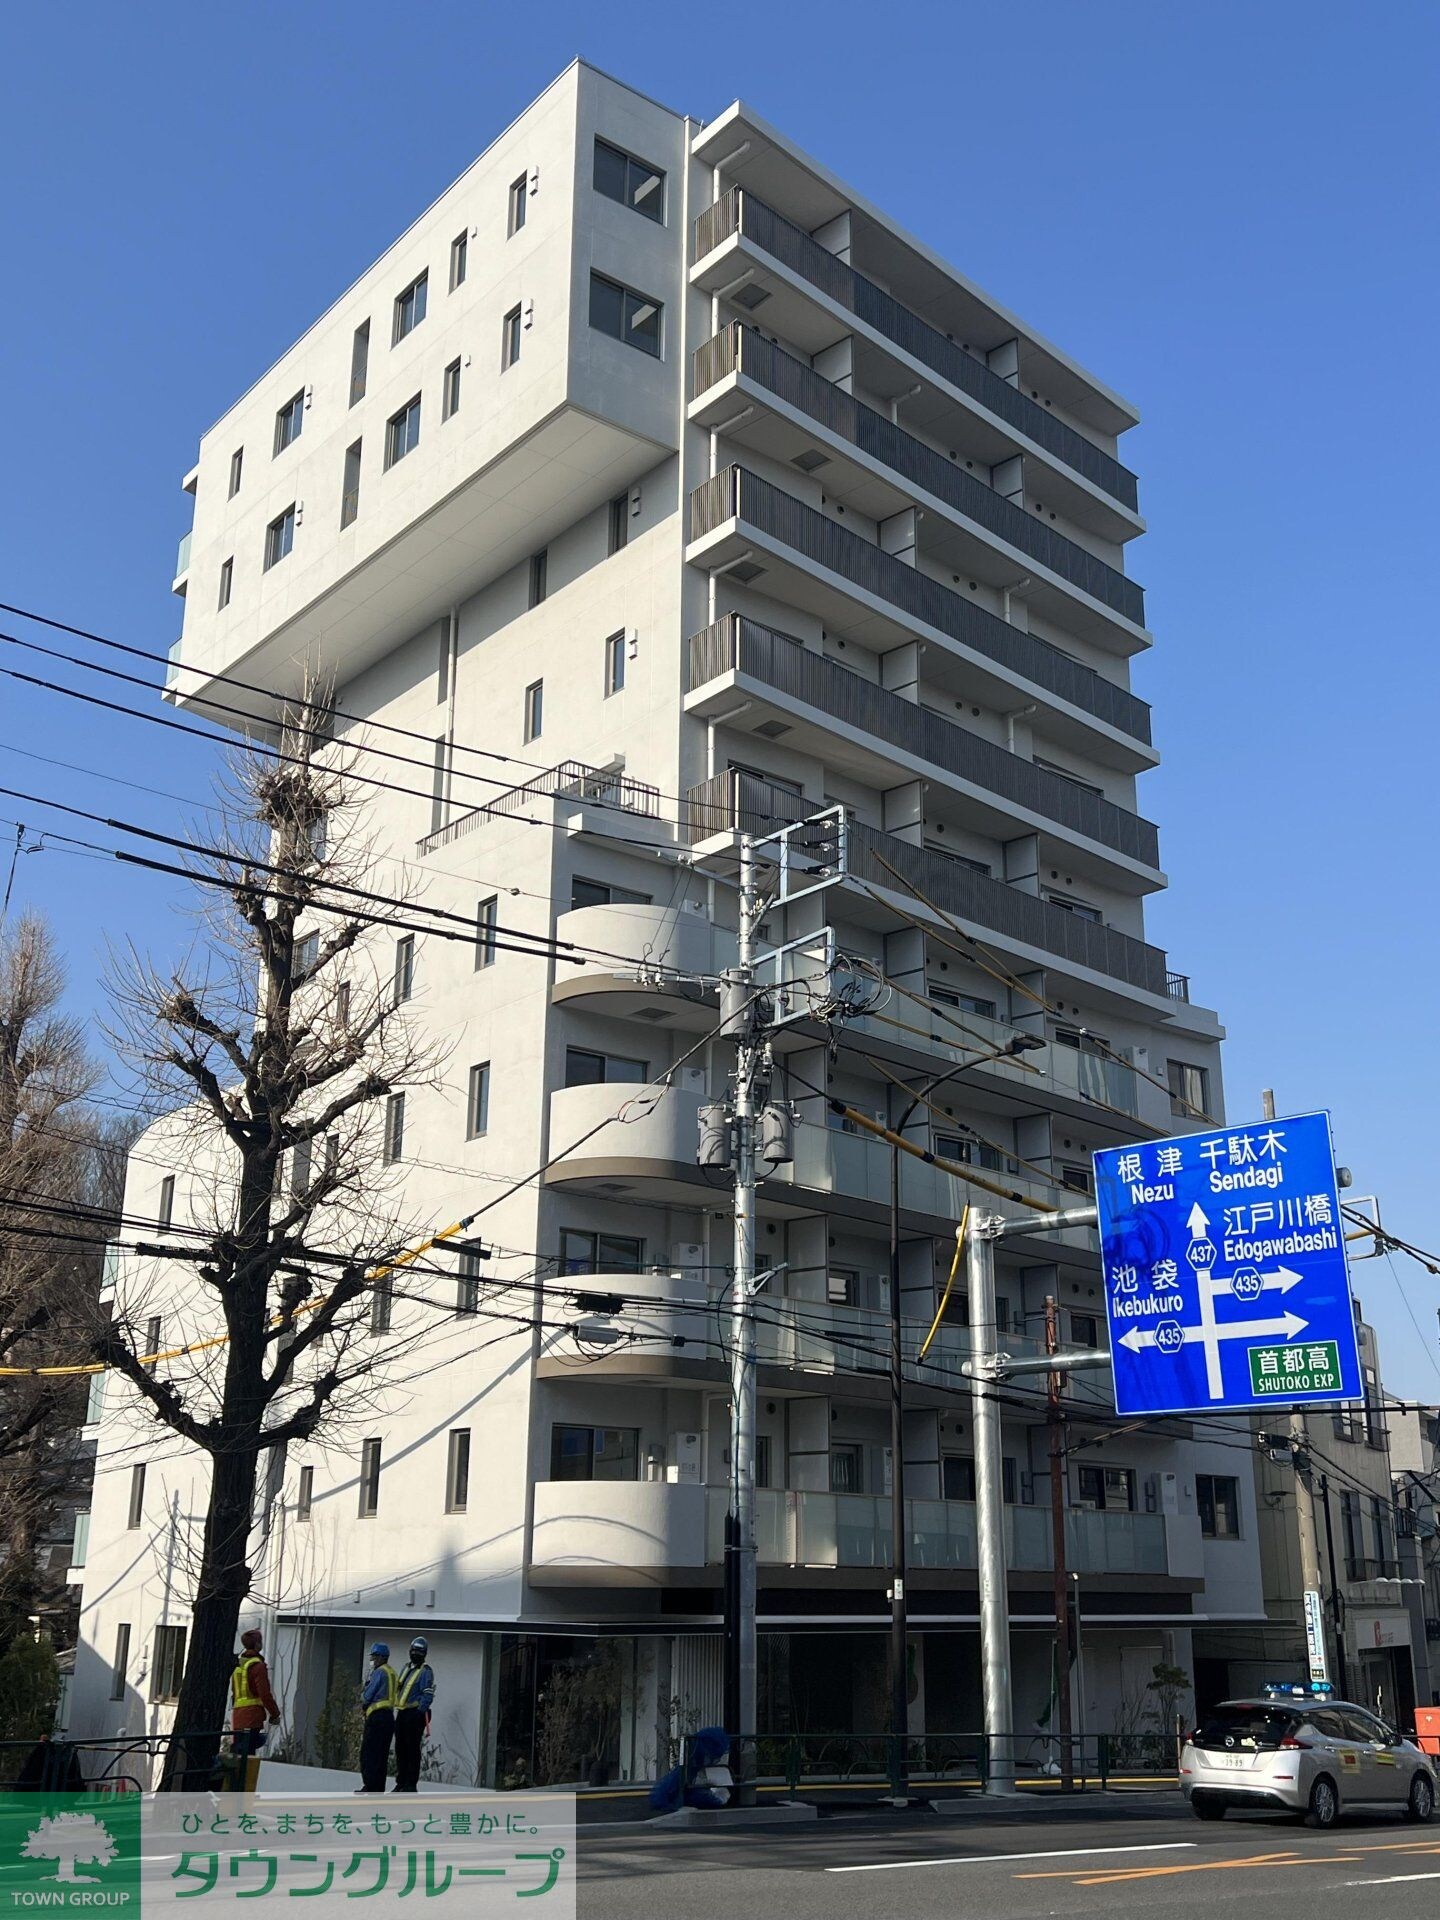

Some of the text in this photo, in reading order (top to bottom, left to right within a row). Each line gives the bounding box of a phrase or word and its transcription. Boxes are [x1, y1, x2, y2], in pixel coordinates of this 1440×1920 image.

[1199, 1129, 1288, 1169] 千駄木
[1117, 1147, 1183, 1184] 根津
[1209, 1161, 1284, 1193] Sendagi
[1131, 1183, 1174, 1205] Nezu
[1223, 1193, 1332, 1237] 江戸川橋
[1190, 1245, 1212, 1263] 437
[1223, 1226, 1338, 1262] Edogawabashi
[1112, 1258, 1180, 1294] 池袋
[1235, 1276, 1259, 1293] 435
[1112, 1293, 1184, 1318] Ikebukuro
[1158, 1328, 1180, 1345] 435
[1257, 1346, 1330, 1375] 首都高
[1258, 1373, 1335, 1392] SHUTOKO EXP
